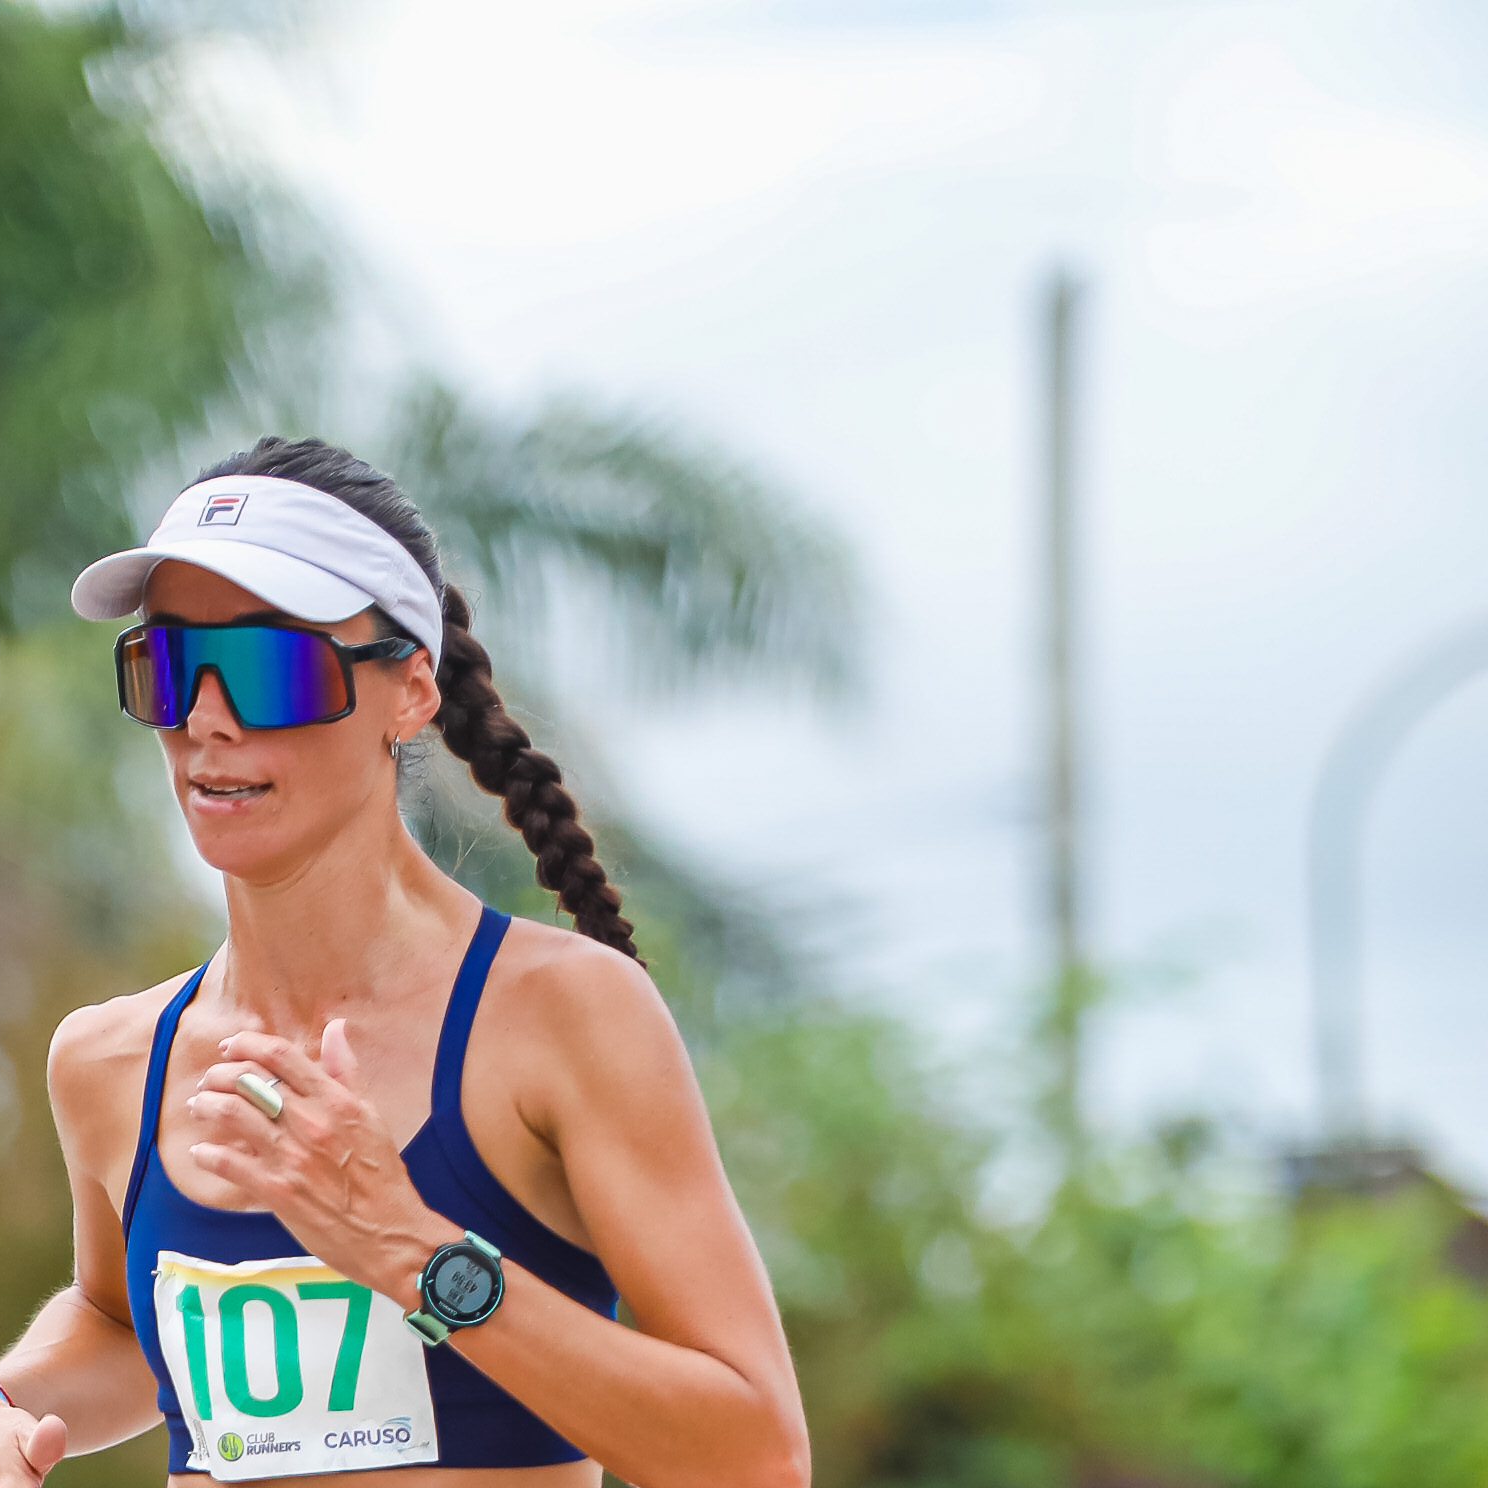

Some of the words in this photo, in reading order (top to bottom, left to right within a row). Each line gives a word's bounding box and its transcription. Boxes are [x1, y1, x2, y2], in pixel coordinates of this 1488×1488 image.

[175, 1280, 373, 1420] 107
[246, 1431, 275, 1445] CLUB
[324, 1426, 411, 1450] CARUSO
